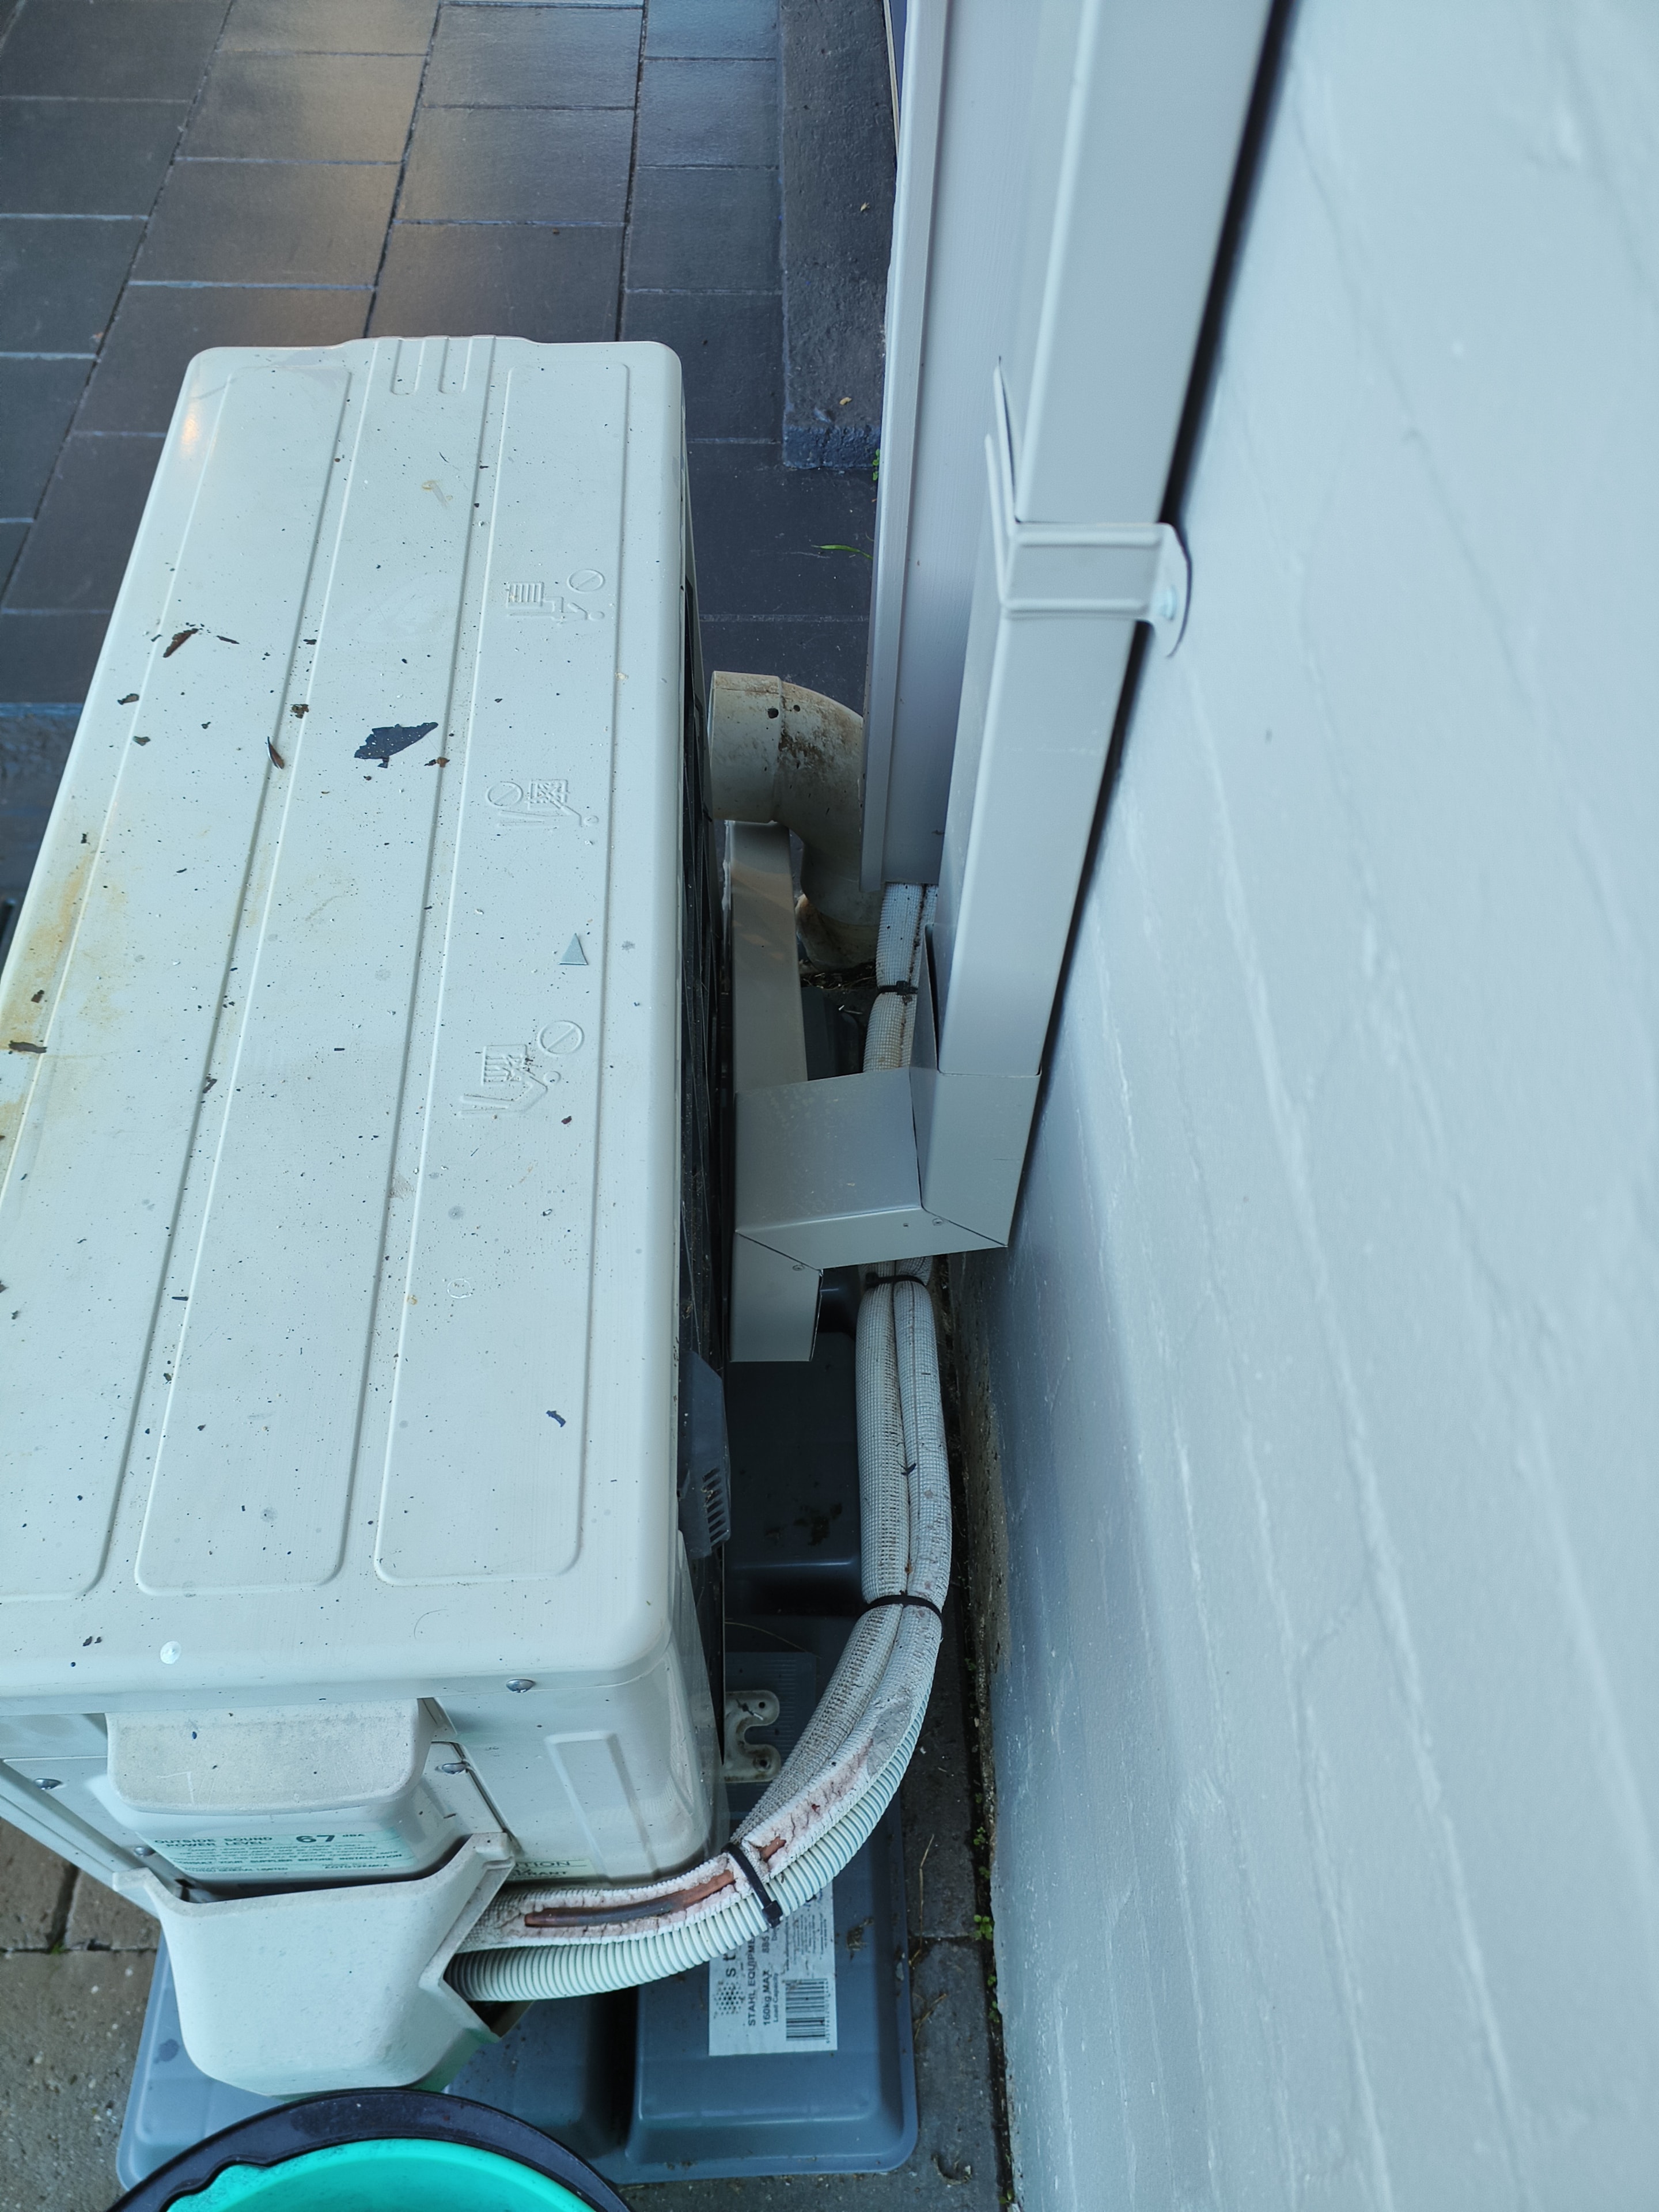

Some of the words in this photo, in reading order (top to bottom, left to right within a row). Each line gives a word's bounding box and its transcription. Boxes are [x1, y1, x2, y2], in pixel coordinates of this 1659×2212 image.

[296, 1835, 335, 1843] 67
[763, 1969, 771, 1994] MAX
[748, 1990, 756, 2026] STAHL
[763, 1996, 771, 2025] 160kg
